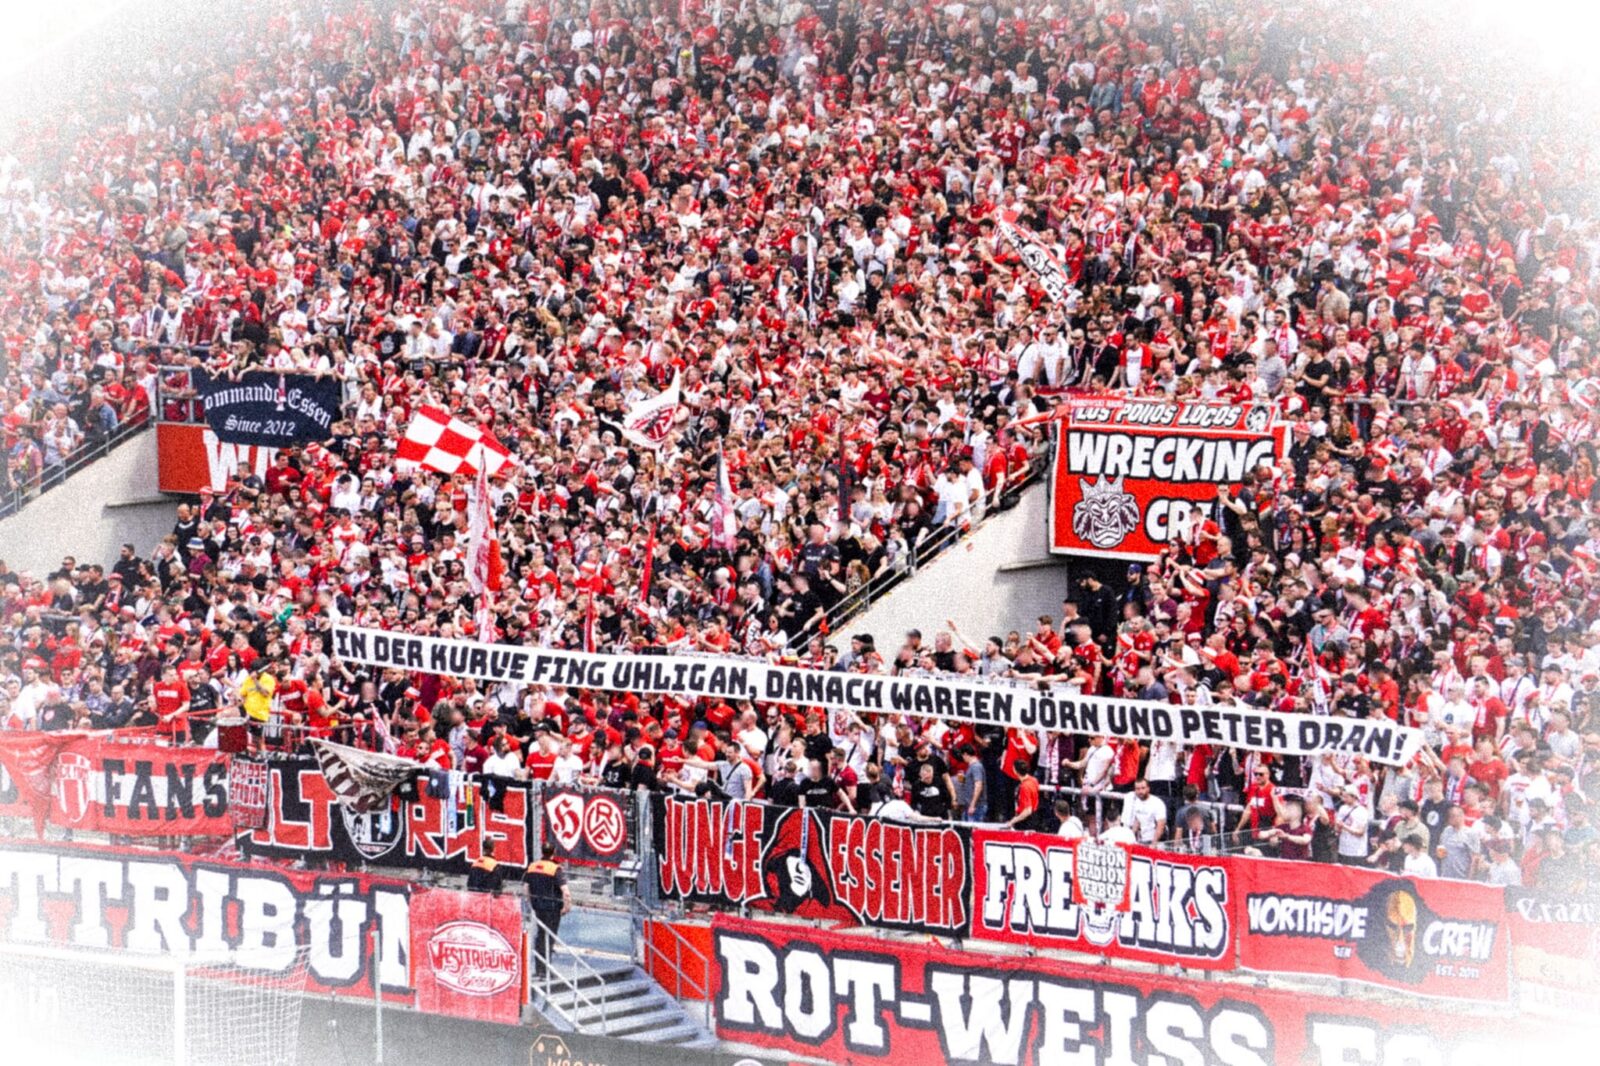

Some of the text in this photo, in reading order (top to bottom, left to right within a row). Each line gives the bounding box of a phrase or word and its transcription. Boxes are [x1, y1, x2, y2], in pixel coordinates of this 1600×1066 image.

[224, 414, 296, 437] Since 2012
[288, 387, 332, 429] Essen
[1179, 404, 1243, 427] LOCOS
[1068, 431, 1274, 482] WRECKING
[335, 628, 1408, 761] IN DER KURVE FING UHLIGAN, DANACH WAREEN JÖRN UND PETER DRAN!
[102, 758, 228, 820] FANS
[660, 798, 966, 930] JUNGE ESSENER
[1078, 861, 1126, 886] STADION
[1422, 920, 1494, 960] CREW
